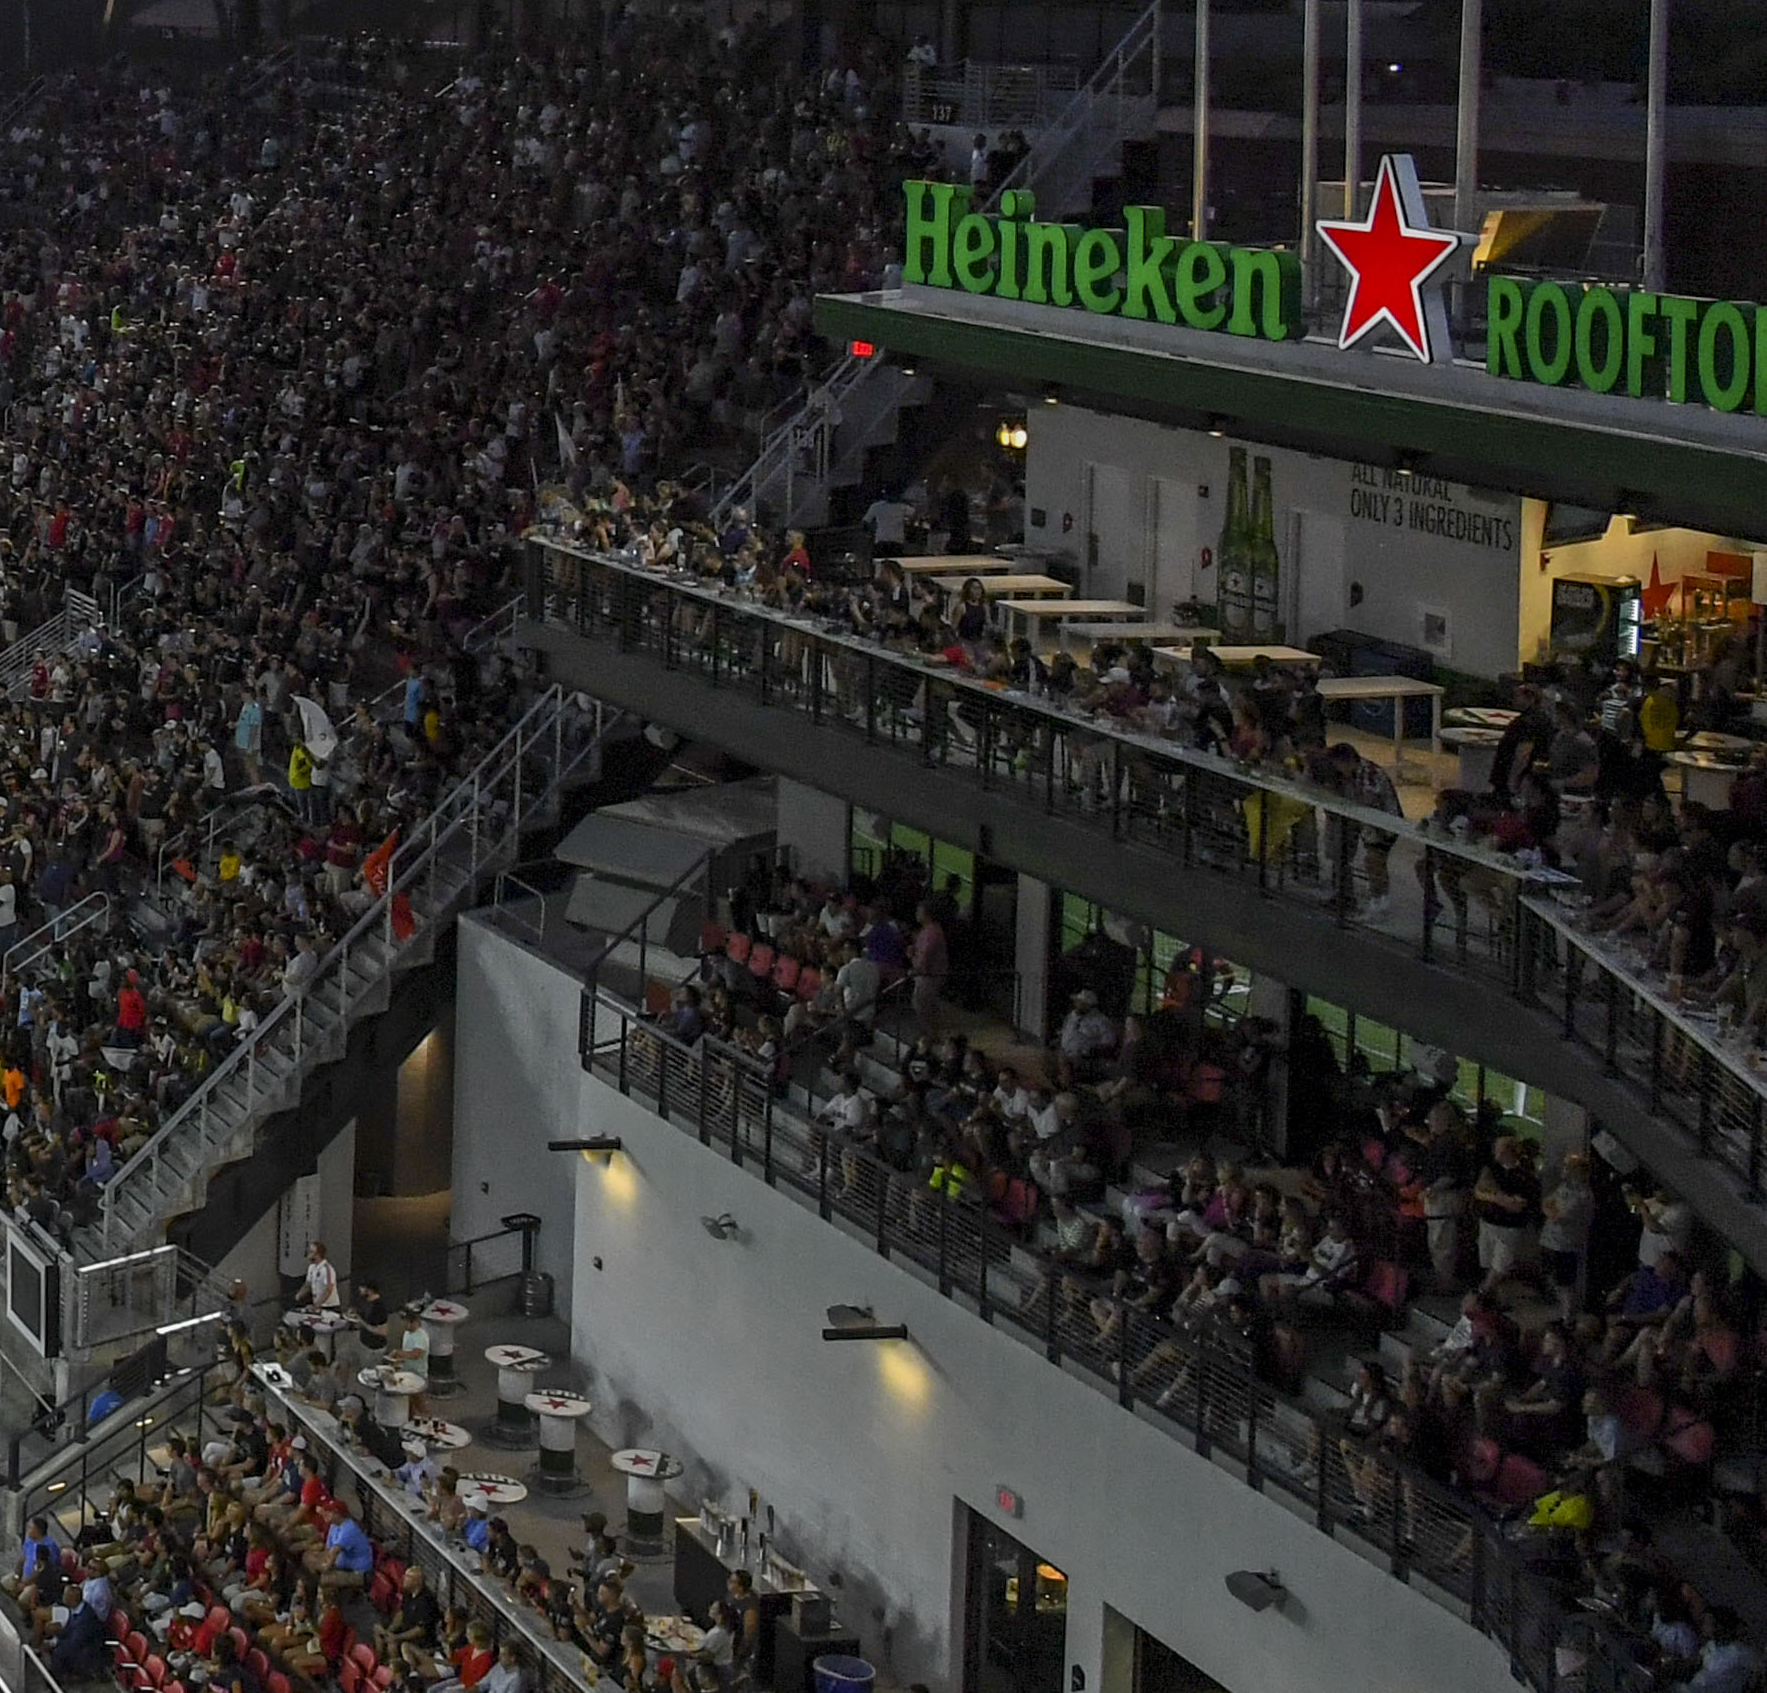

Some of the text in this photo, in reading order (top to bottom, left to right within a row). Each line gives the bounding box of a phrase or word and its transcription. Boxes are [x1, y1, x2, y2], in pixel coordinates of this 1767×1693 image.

[902, 179, 1295, 342] Heineken
[1486, 274, 1767, 417] ROOFTO
[1351, 488, 1513, 551] ONLY 3 INGREDIENTS
